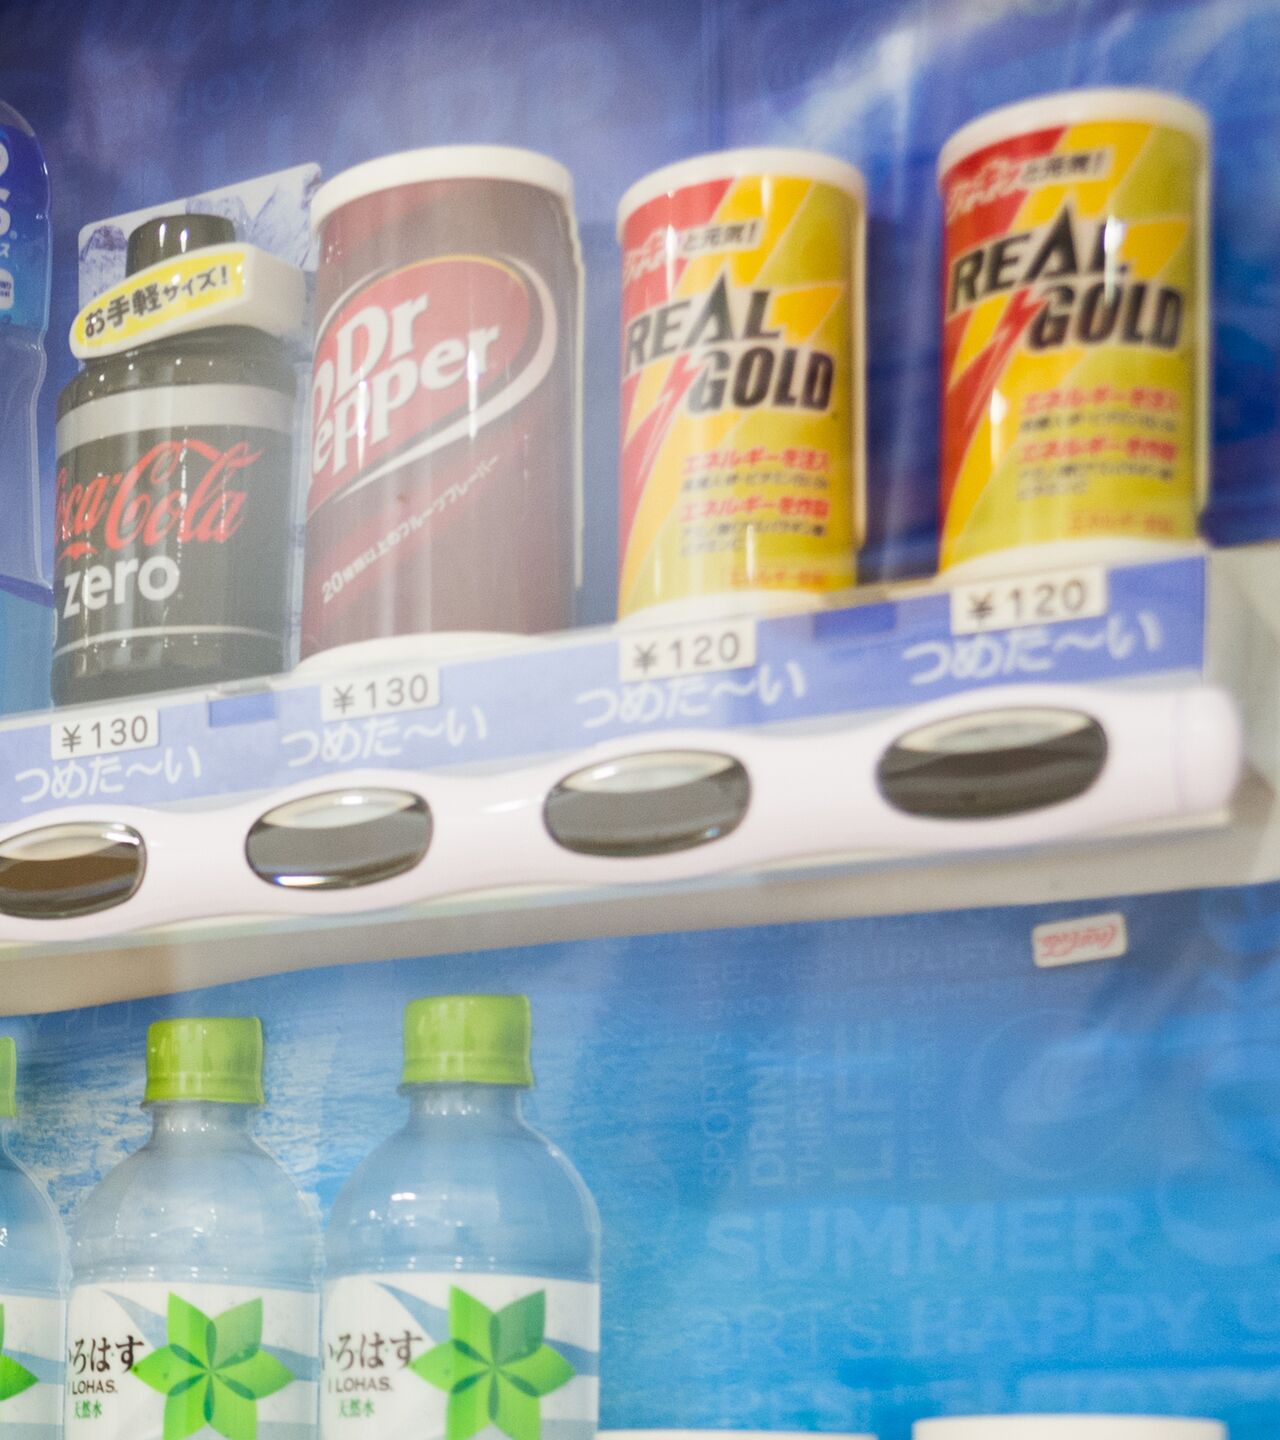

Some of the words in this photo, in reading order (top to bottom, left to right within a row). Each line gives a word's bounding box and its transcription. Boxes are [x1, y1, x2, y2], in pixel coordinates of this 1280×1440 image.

[948, 204, 1130, 316] REAL
[335, 292, 429, 387] Dr
[625, 271, 783, 377] REAL
[1025, 282, 1185, 352] GOLD
[686, 349, 838, 416] GOLD
[63, 554, 180, 619] zero
[967, 579, 1089, 624] ¥120
[634, 632, 740, 674] ¥120
[333, 674, 429, 714] ¥130
[61, 716, 149, 754] ¥130
[71, 1378, 117, 1395] LOHAS
